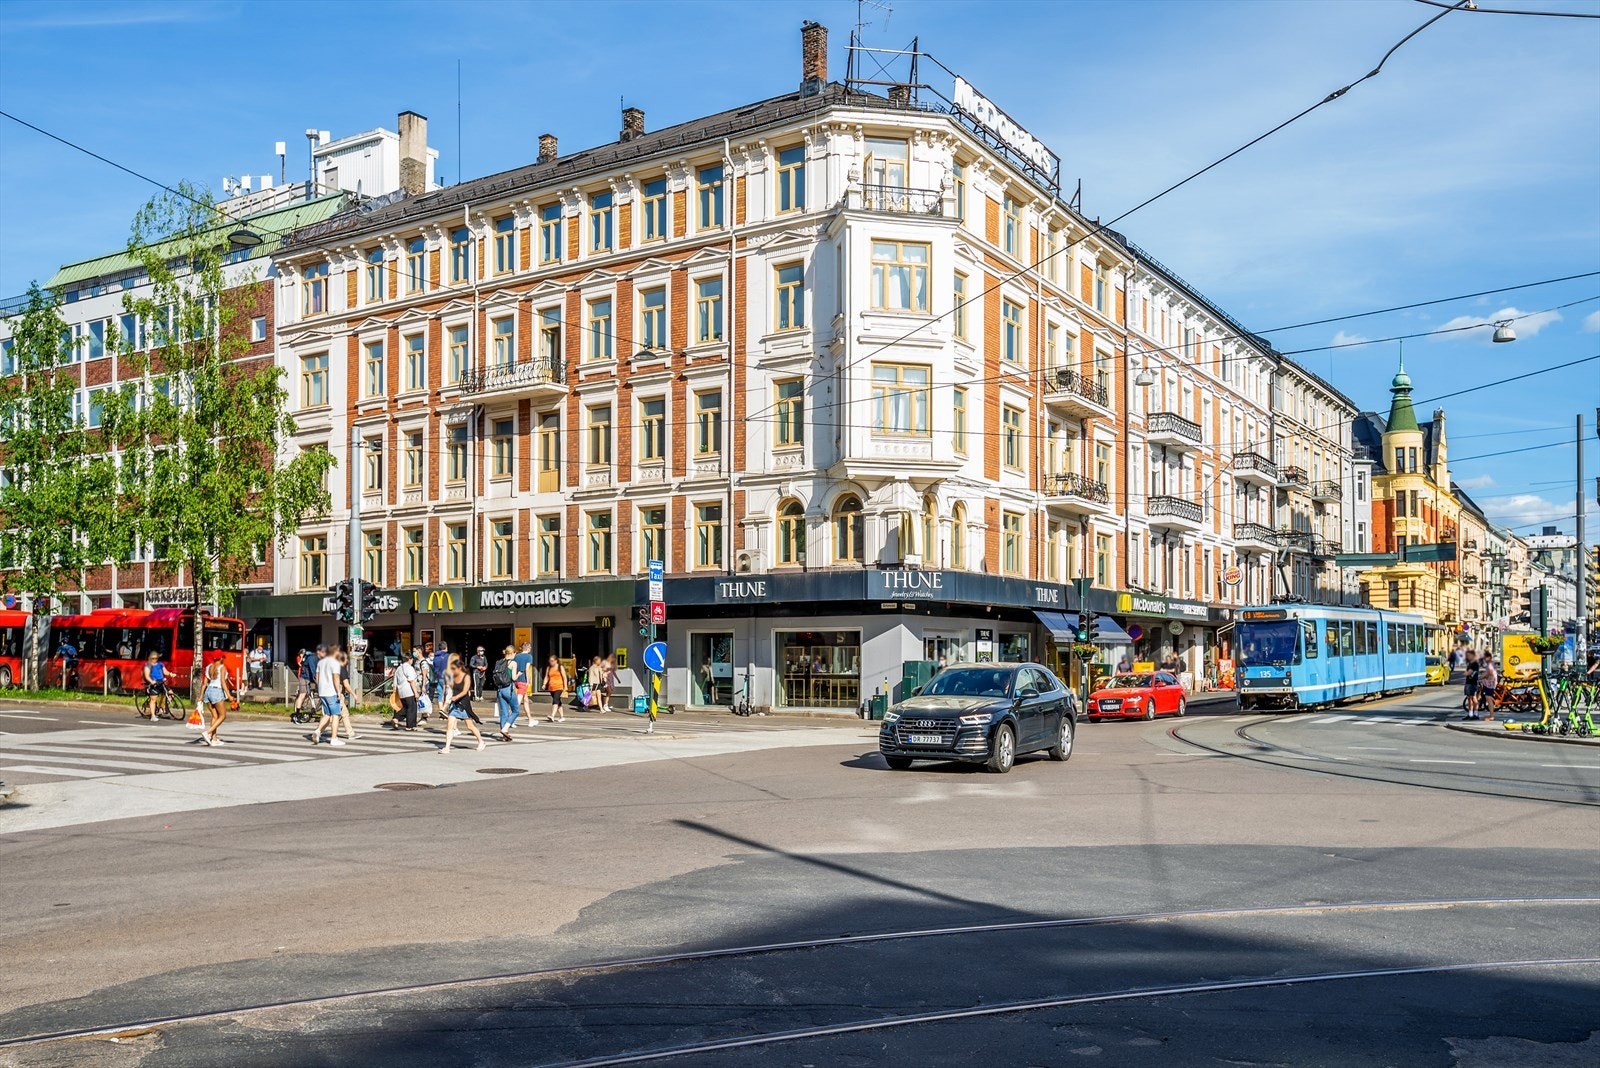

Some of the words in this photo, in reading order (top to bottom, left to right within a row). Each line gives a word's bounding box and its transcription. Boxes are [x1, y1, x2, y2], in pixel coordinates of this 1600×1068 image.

[881, 571, 943, 589] THUNE
[1225, 573, 1240, 581] KING
[480, 588, 572, 607] McDonald's
[719, 581, 767, 598] THUNE
[1035, 587, 1059, 603] THUNE
[1133, 598, 1166, 613] McDonald's
[1260, 670, 1272, 678] 135
